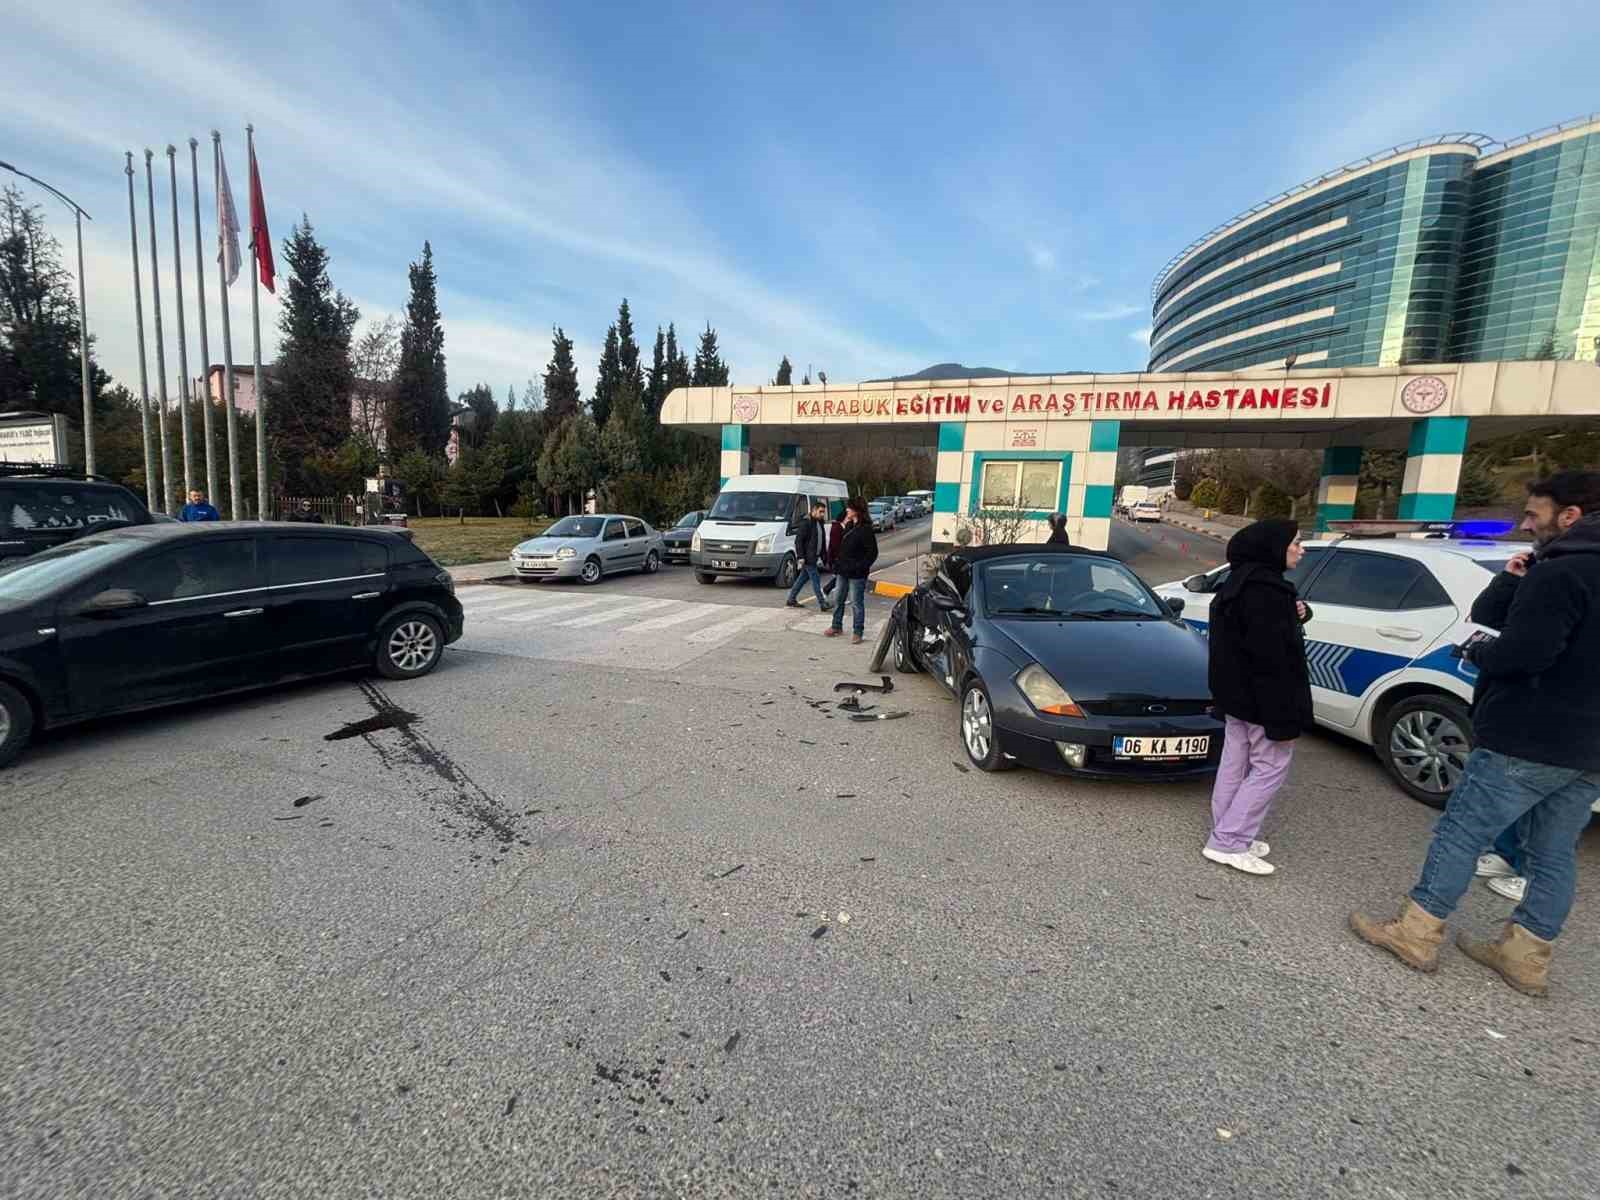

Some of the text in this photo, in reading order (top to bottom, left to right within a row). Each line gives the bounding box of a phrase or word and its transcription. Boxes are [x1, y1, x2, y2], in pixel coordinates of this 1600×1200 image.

[977, 399, 1004, 414] ve
[1012, 390, 1159, 417] ARAŞTIRMA
[1167, 382, 1332, 410] HASTANESİ
[1124, 737, 1208, 754] 06 KA 4190
